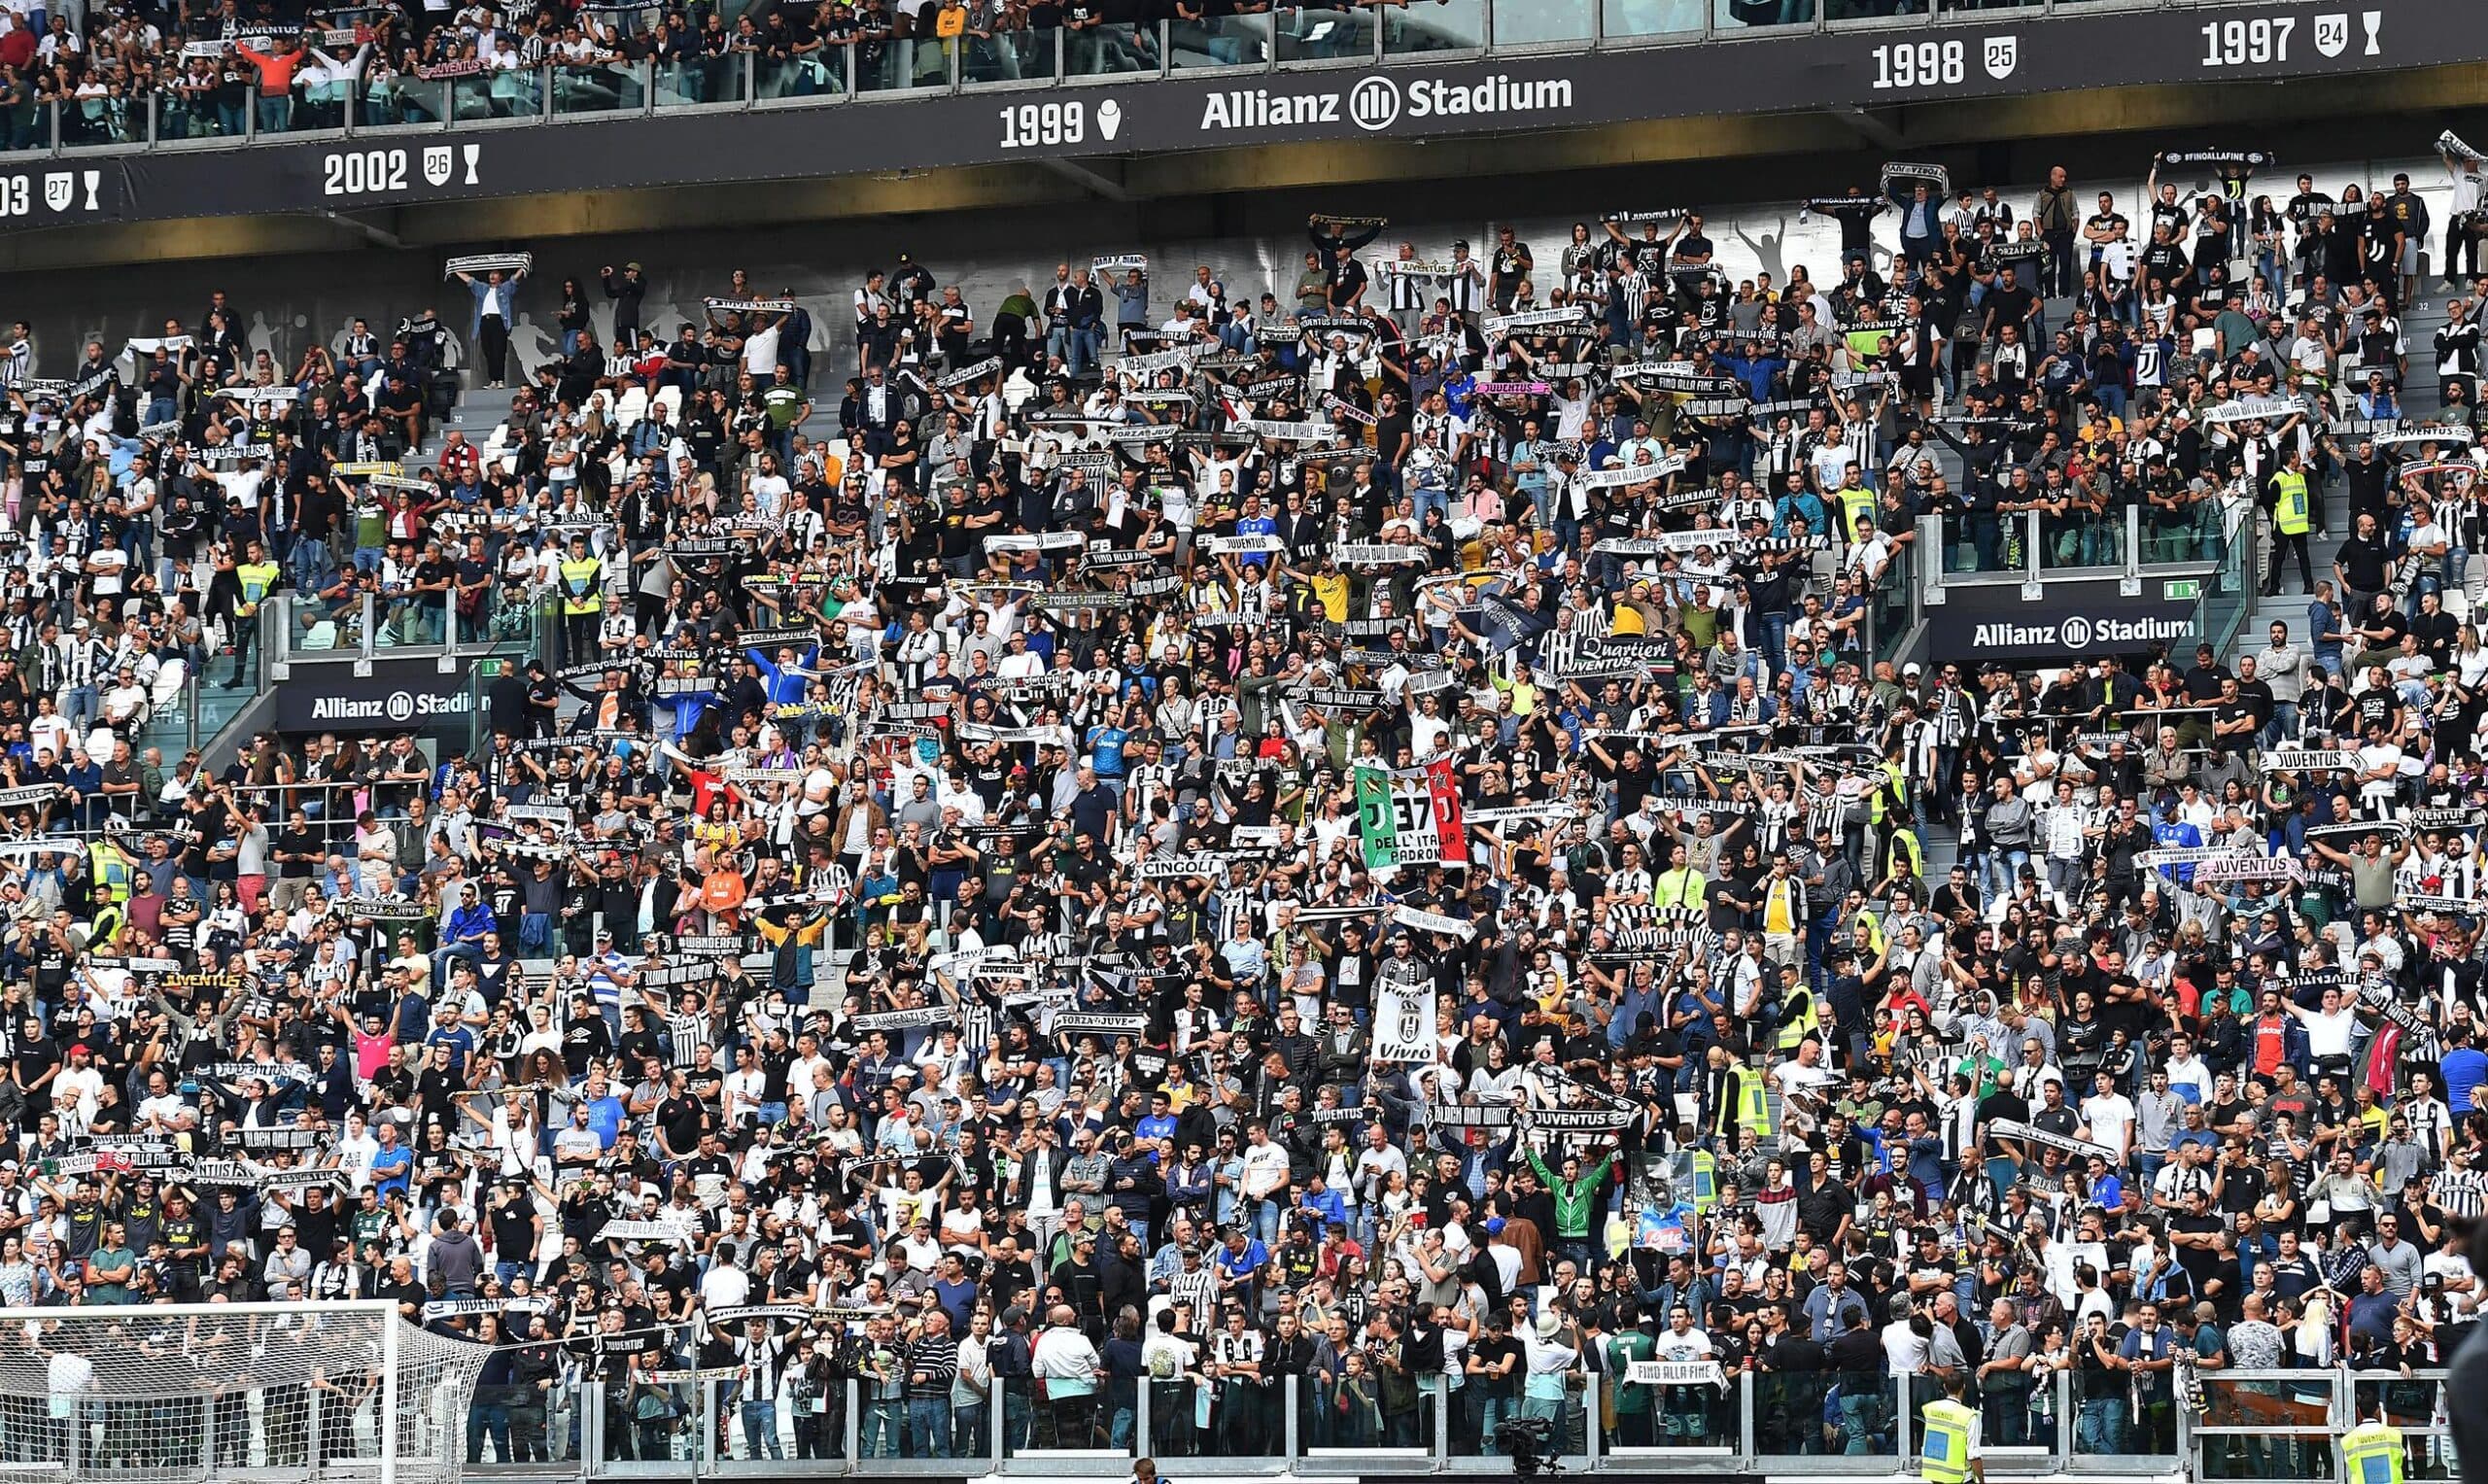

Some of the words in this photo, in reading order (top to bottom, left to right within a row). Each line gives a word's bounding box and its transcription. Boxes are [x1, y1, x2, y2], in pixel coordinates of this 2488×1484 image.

[240, 25, 299, 34] JUVENTUS
[2201, 17, 2296, 66] 1997
[2320, 23, 2343, 45] 24
[434, 60, 481, 74] JUVENTUS
[1872, 40, 1964, 88] 1998
[1988, 45, 2013, 68] 25
[1200, 89, 1340, 130] Allianz
[1408, 74, 1572, 118] Stadium
[1000, 101, 1084, 148] 1999
[325, 149, 408, 194] 2002
[428, 154, 448, 175] 26
[50, 180, 69, 200] 27
[1631, 210, 1669, 222] JUVENTUS
[1401, 262, 1446, 274] JUVENTUS
[720, 300, 780, 309] JUVENTUS
[2418, 302, 2429, 311] 32
[1851, 320, 1903, 330] JUVENTUS
[1247, 377, 1296, 393] JUVENTUS
[1659, 377, 1677, 389] FINO
[1678, 377, 1697, 390] ALLA
[1698, 379, 1713, 391] FINE
[454, 414, 463, 423] 32
[2395, 427, 2453, 436] JUVENTUS
[1665, 488, 1718, 504] JUVENTUS
[561, 512, 605, 524] JUVENTUS
[1227, 536, 1267, 549] JUVENTUS
[1974, 622, 2056, 647] Allianz
[2095, 616, 2194, 642] Stadium
[642, 648, 699, 660] JUVENTUS
[1581, 638, 1669, 662] Quartieri
[1314, 691, 1332, 704] FINO
[1335, 692, 1354, 705] ALLA
[1356, 693, 1374, 706] FINE
[312, 697, 383, 720] Allianz
[2277, 751, 2341, 769] JUVENTUS
[1393, 797, 1431, 832] 37
[1391, 848, 1446, 863] PADRONI
[1144, 859, 1215, 875] CINGOLI
[2213, 858, 2287, 873] JUVENTUS
[495, 895, 512, 915] 37
[162, 974, 242, 987] JUVENTUS
[874, 1011, 931, 1027] JUVENTUS
[1062, 1016, 1092, 1026] FORZA
[1100, 1016, 1128, 1027] JUVE
[1380, 1044, 1431, 1060] Vivrò
[1311, 1108, 1364, 1122] JUVENTUS
[1434, 1106, 1462, 1124] BLACK
[1464, 1106, 1481, 1124] AND
[1484, 1106, 1511, 1124] WHITE
[1537, 1112, 1607, 1125] JUVENTUS
[131, 1153, 152, 1166] ALLA
[154, 1153, 173, 1165] FINE
[168, 1233, 190, 1244] Jeep
[1292, 1262, 1311, 1273] Jeep
[605, 1338, 644, 1351] JUVENTUS
[1621, 1344, 1633, 1363] 1
[1638, 1365, 1660, 1380] FINO
[1663, 1365, 1684, 1379] ALLA
[1686, 1363, 1710, 1379] FINE
